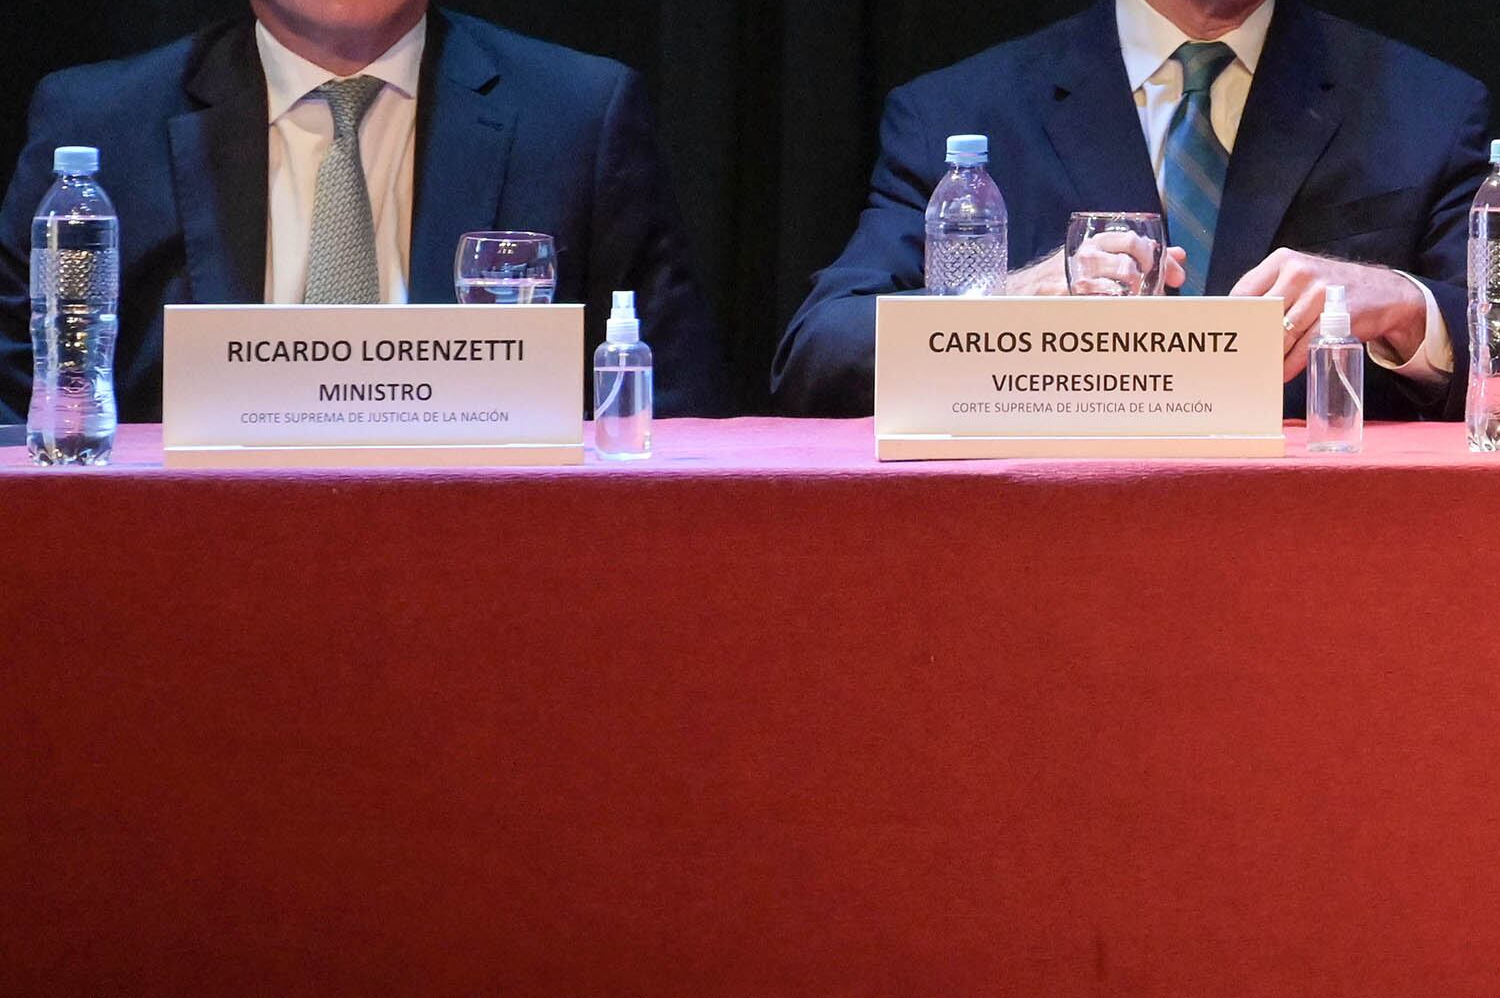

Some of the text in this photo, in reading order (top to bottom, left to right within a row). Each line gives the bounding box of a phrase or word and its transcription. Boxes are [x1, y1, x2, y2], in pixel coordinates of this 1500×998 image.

[227, 340, 523, 362] RICARDO LORENZETTI
[929, 332, 1238, 353] CARLOS ROSENKRANTZ
[320, 383, 432, 401] MINISTRO
[992, 374, 1173, 392] VICEPRESIDENTE
[951, 400, 1213, 413] CORTE SUPREMA DE JUSTICIA DE LA NACIÓN
[240, 410, 509, 423] CORTE SUPREMA DE JUSTICIA DE LA NACIÓN
